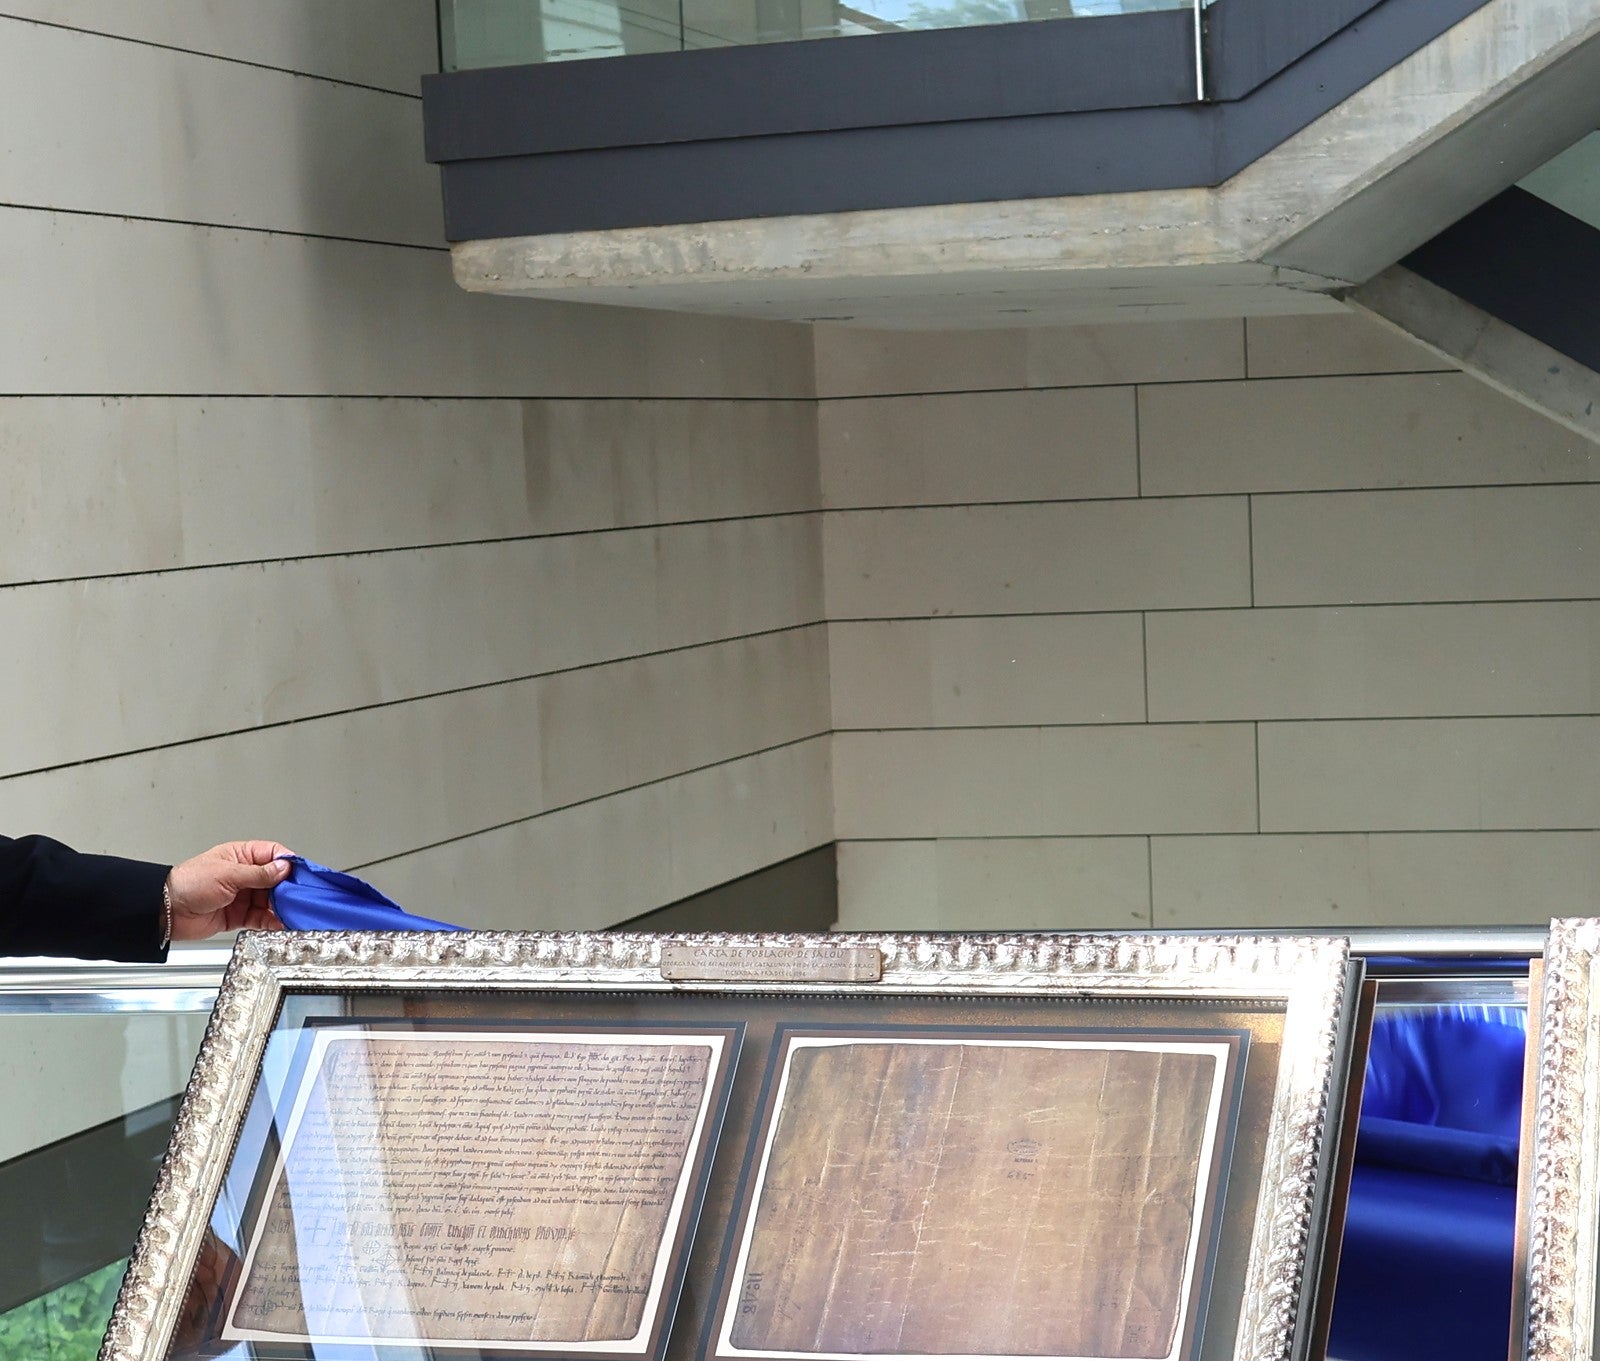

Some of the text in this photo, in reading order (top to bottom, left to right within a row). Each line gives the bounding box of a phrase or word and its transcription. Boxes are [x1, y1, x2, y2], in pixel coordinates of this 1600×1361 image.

[694, 949, 727, 958] CARTA
[731, 949, 743, 958] DE
[797, 949, 809, 959] DE
[811, 950, 845, 959] SALOU
